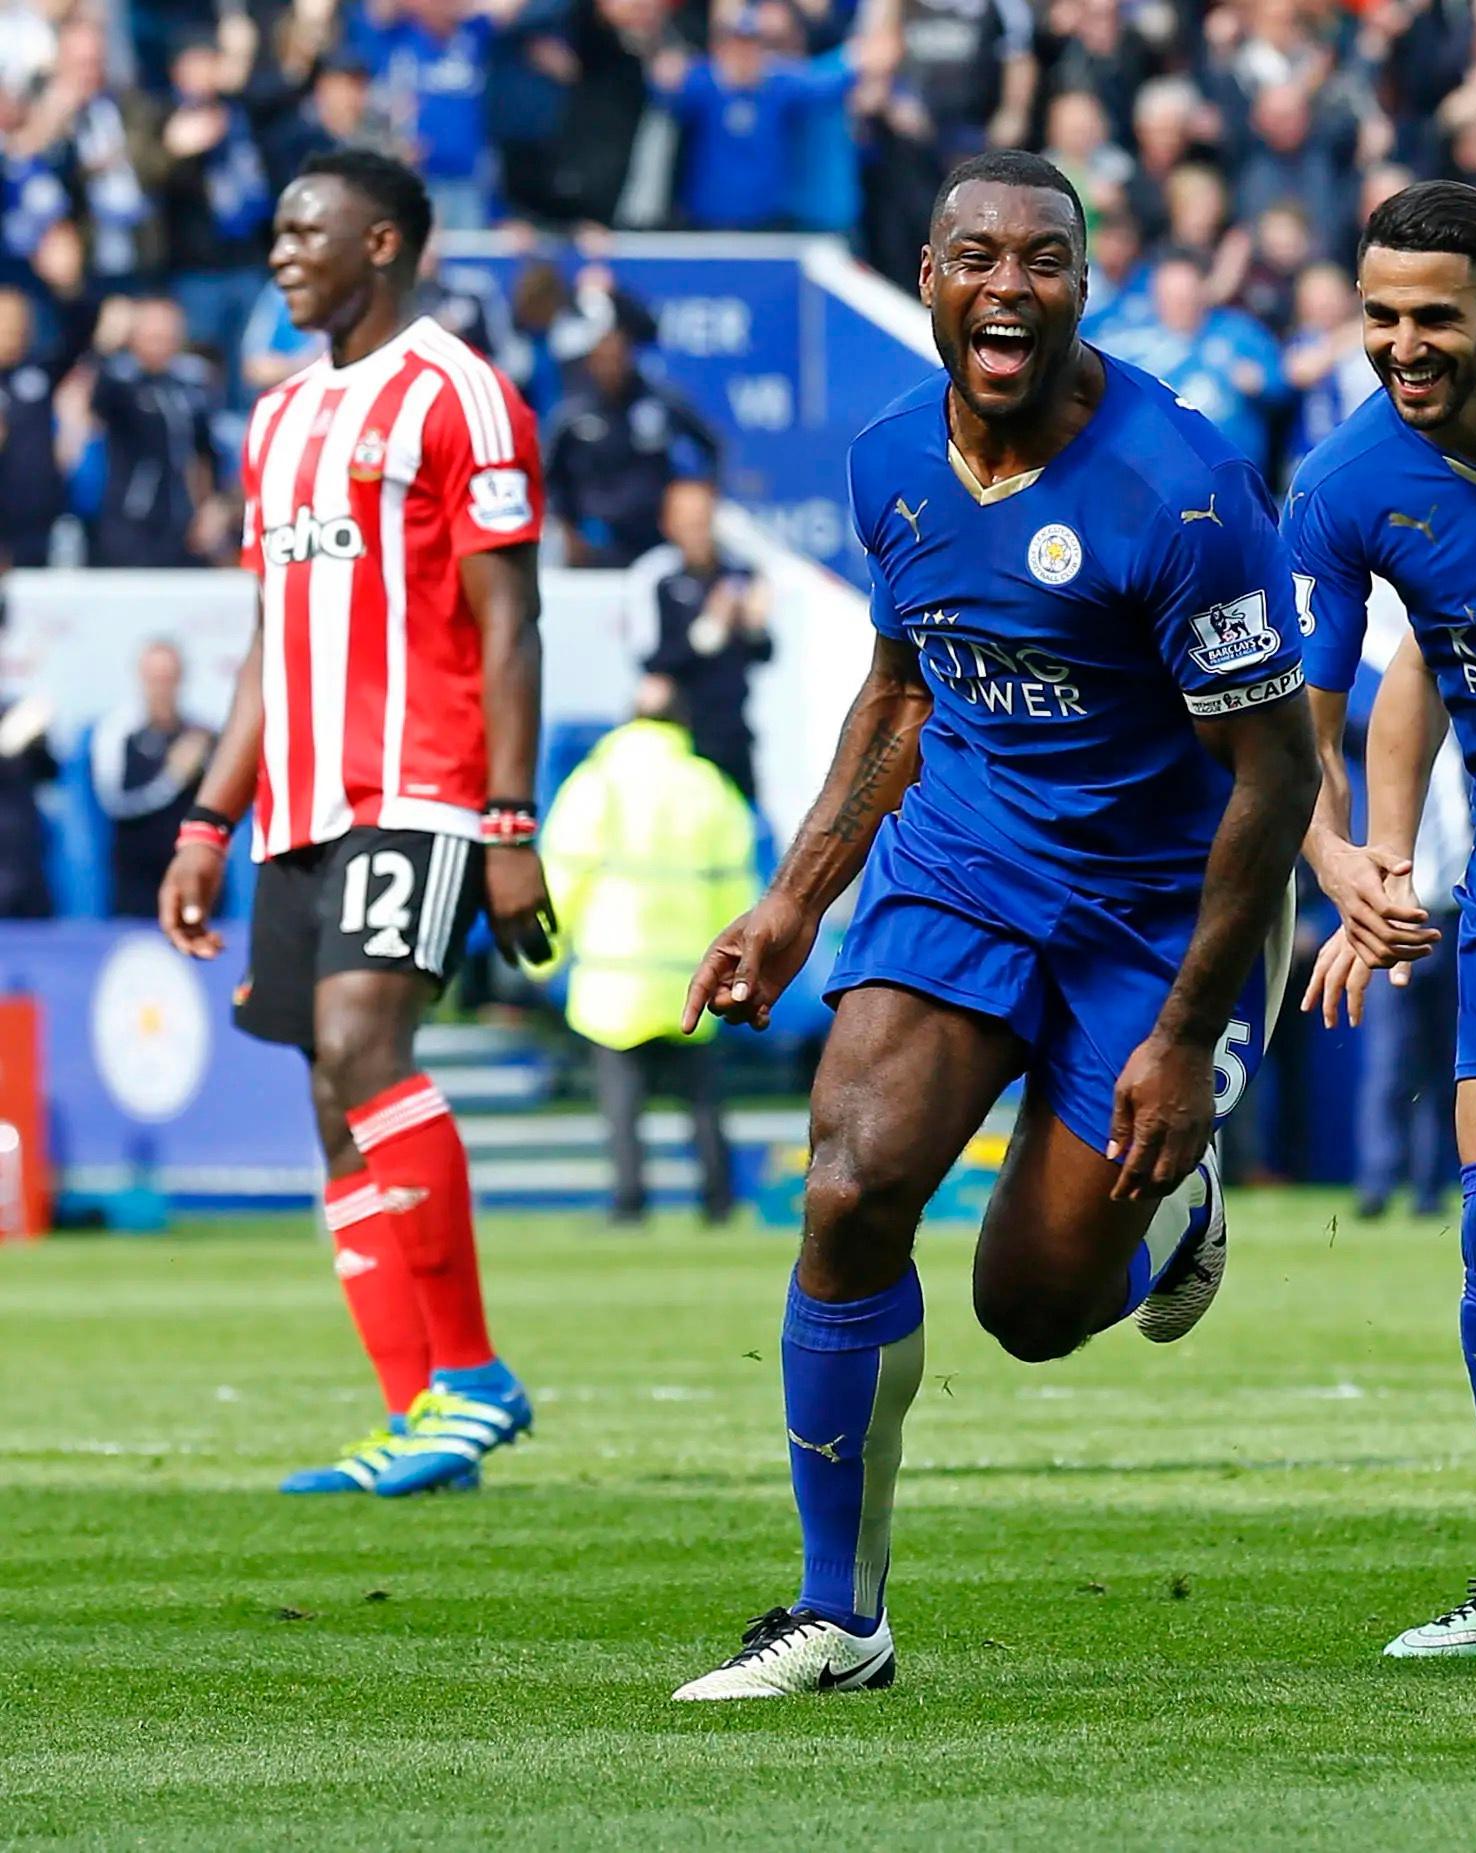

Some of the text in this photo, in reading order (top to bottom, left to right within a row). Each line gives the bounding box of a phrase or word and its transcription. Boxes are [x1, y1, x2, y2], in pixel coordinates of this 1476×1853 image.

[1209, 638, 1256, 660] BARCLAYS
[1246, 669, 1303, 702] CAPT
[339, 850, 415, 933] 12
[1213, 1019, 1250, 1118] 5
